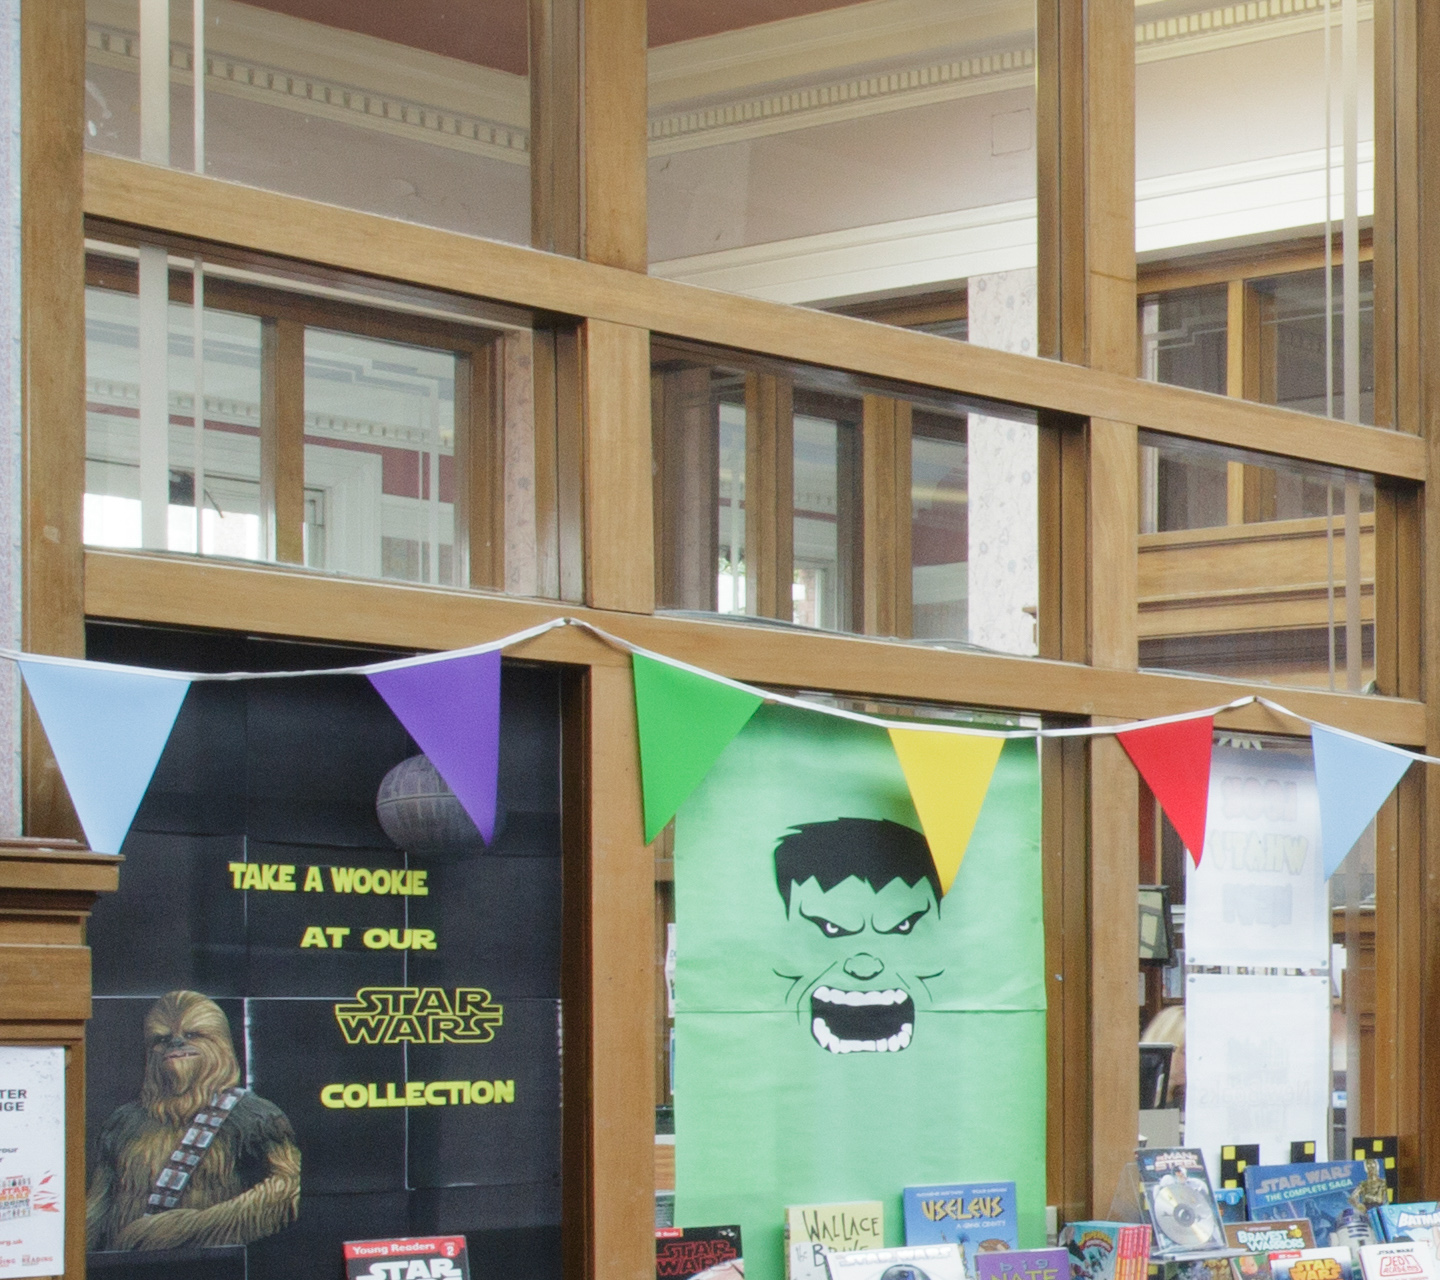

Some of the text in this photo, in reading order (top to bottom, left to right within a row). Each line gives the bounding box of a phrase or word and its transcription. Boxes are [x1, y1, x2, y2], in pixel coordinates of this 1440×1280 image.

[229, 863, 428, 896] TAKE A WOOKIE
[300, 926, 437, 950] AT OUR
[335, 987, 503, 1016] STAR
[336, 1015, 503, 1044] WARS
[321, 1080, 514, 1108] COLLECTION
[1255, 1164, 1352, 1194] STAR WARS
[1265, 1179, 1353, 1203] THE COMPLETE SAGA
[802, 1209, 880, 1242] WALLACE
[1237, 1229, 1289, 1246] BRAVEST
[353, 1242, 454, 1257] Young Readers 2
[657, 1240, 736, 1259] STAR
[1290, 1258, 1341, 1272] STAR
